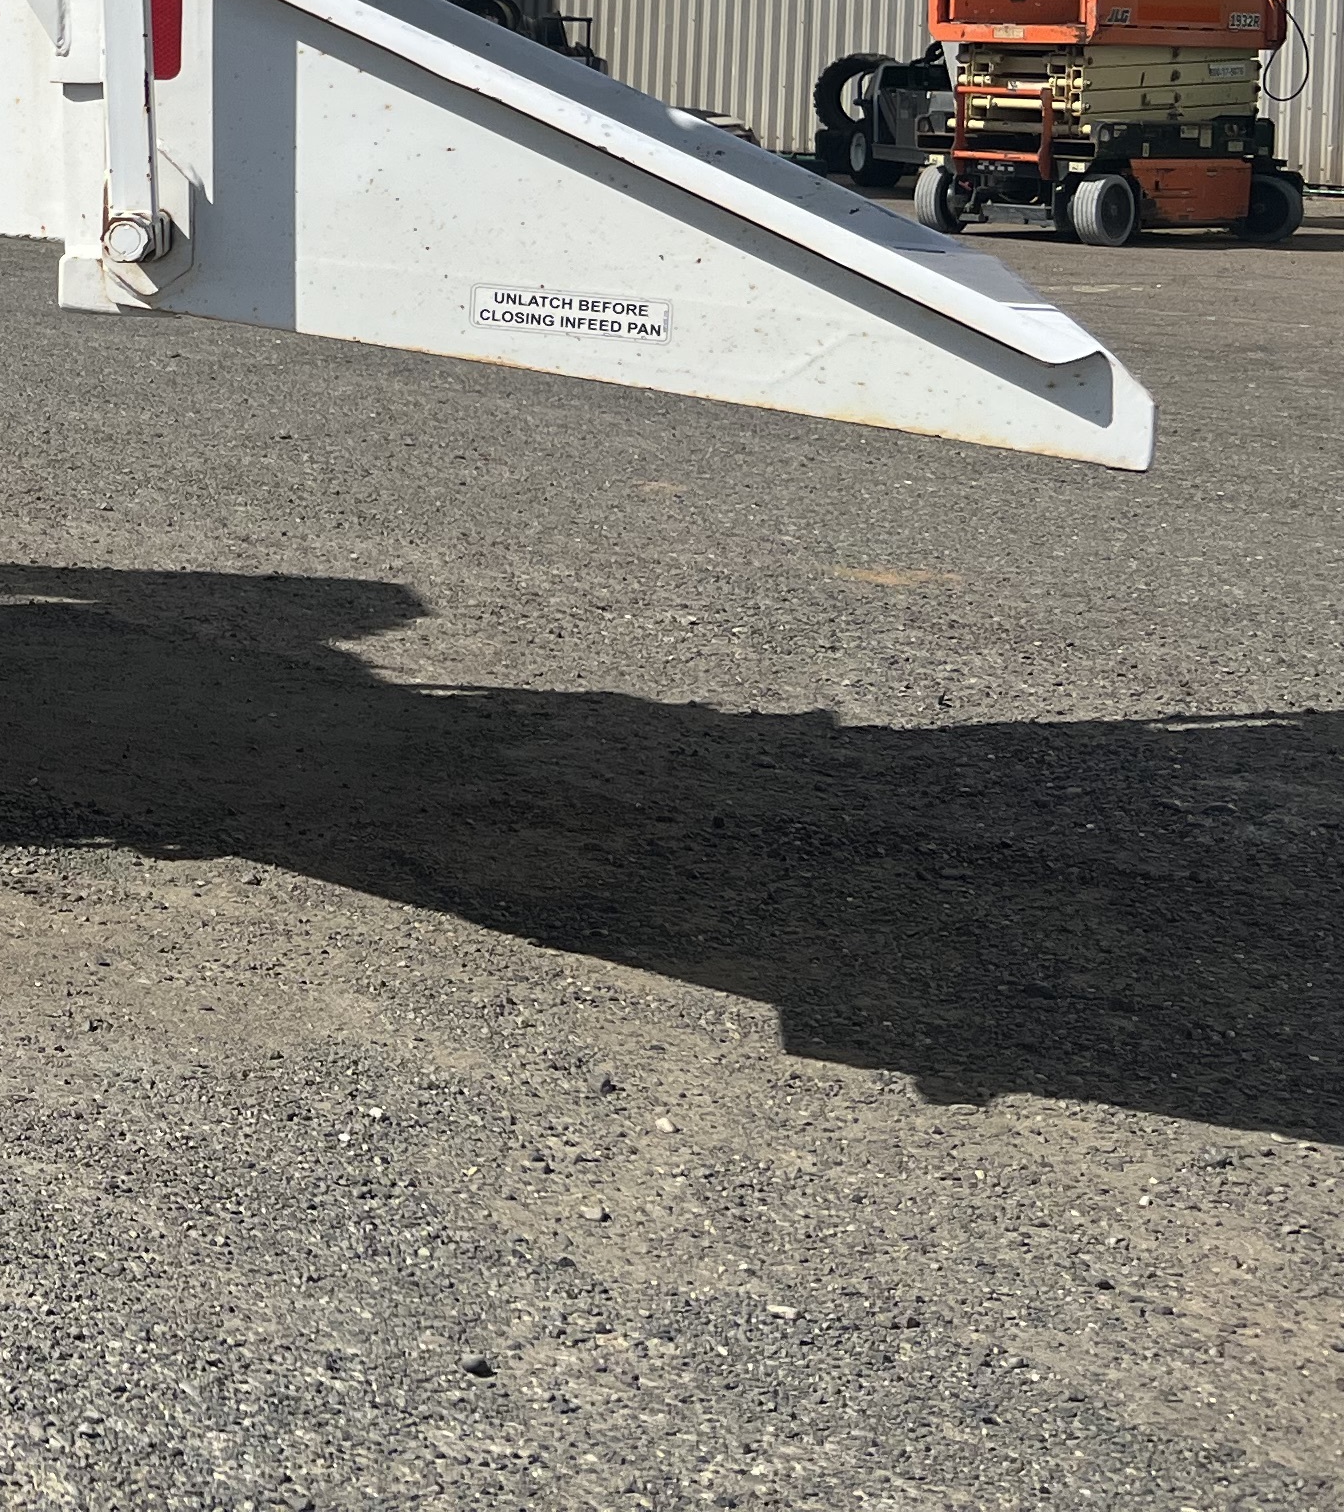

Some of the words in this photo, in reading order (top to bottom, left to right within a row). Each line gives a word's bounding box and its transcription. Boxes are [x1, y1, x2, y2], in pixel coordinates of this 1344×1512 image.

[1107, 8, 1130, 23] JLG
[1229, 13, 1261, 29] 1932R
[494, 292, 573, 310] UNLATCH
[578, 300, 649, 317] BEFORE
[479, 309, 555, 327] CLOSING
[560, 316, 622, 333] INFEED
[627, 322, 662, 337] PAN
